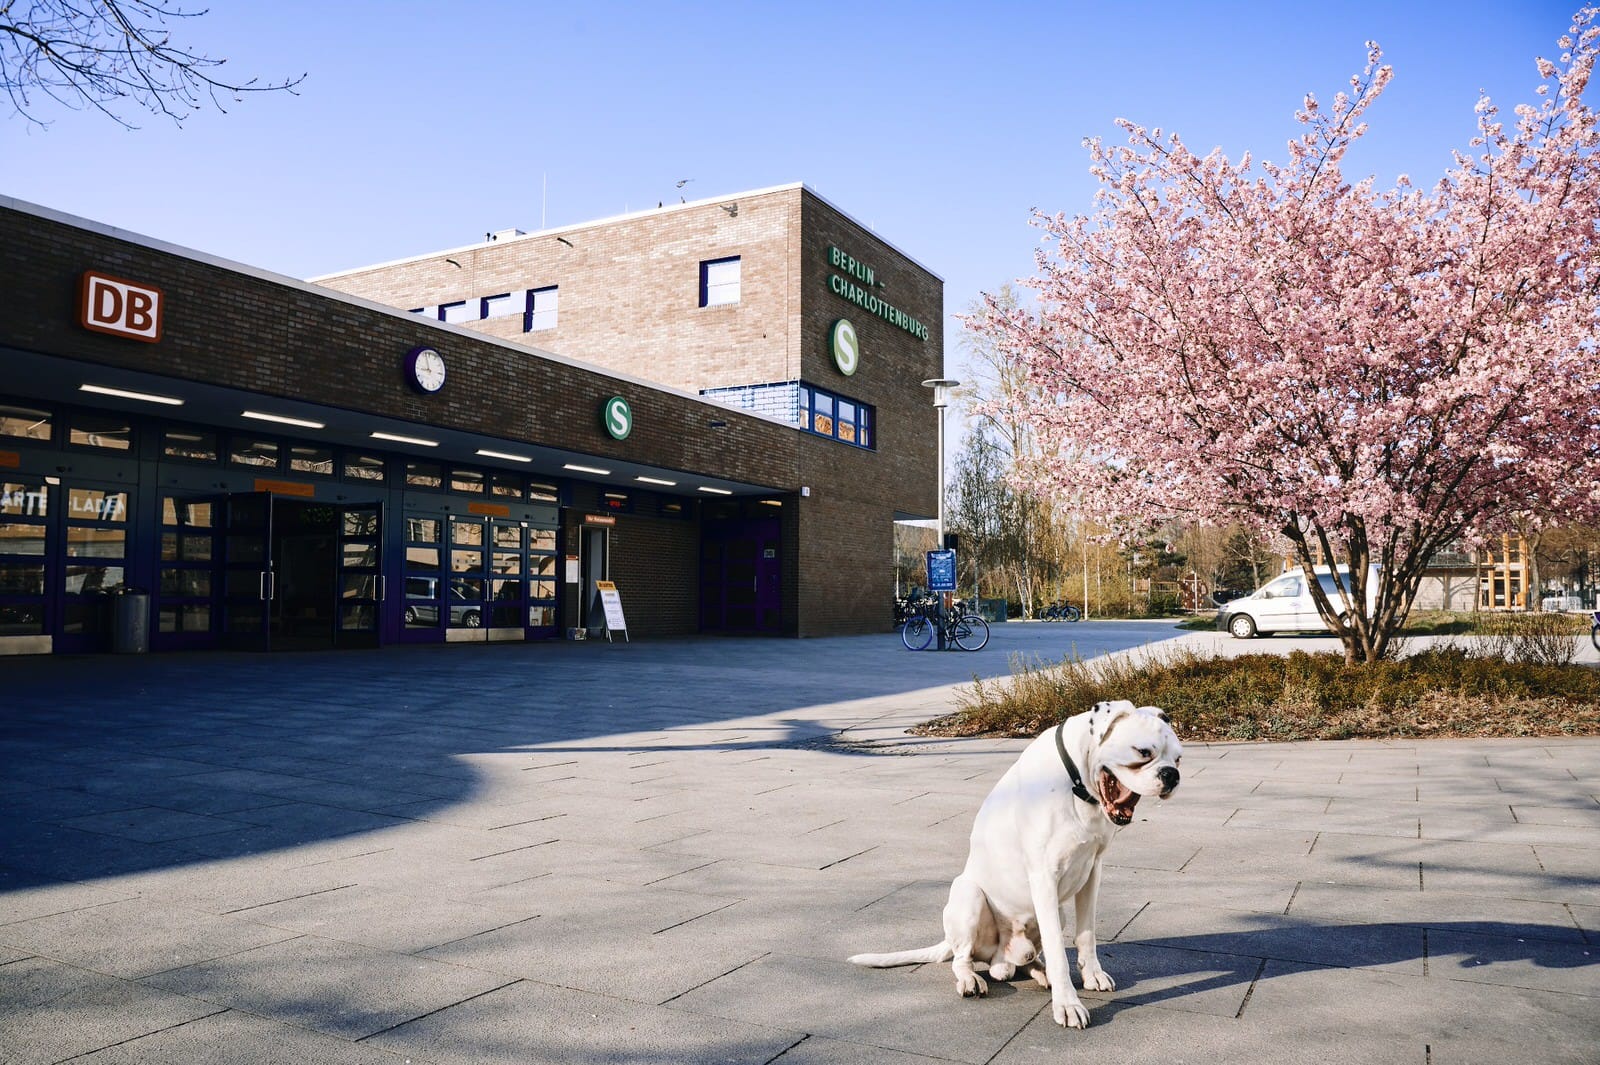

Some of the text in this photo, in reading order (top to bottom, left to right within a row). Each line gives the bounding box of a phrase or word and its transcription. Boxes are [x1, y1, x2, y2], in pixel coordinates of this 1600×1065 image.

[832, 246, 875, 286] BERLIN
[93, 281, 153, 332] DB
[832, 274, 929, 341] CHARLOTTENBURG
[837, 323, 855, 372] S
[611, 401, 628, 436] S
